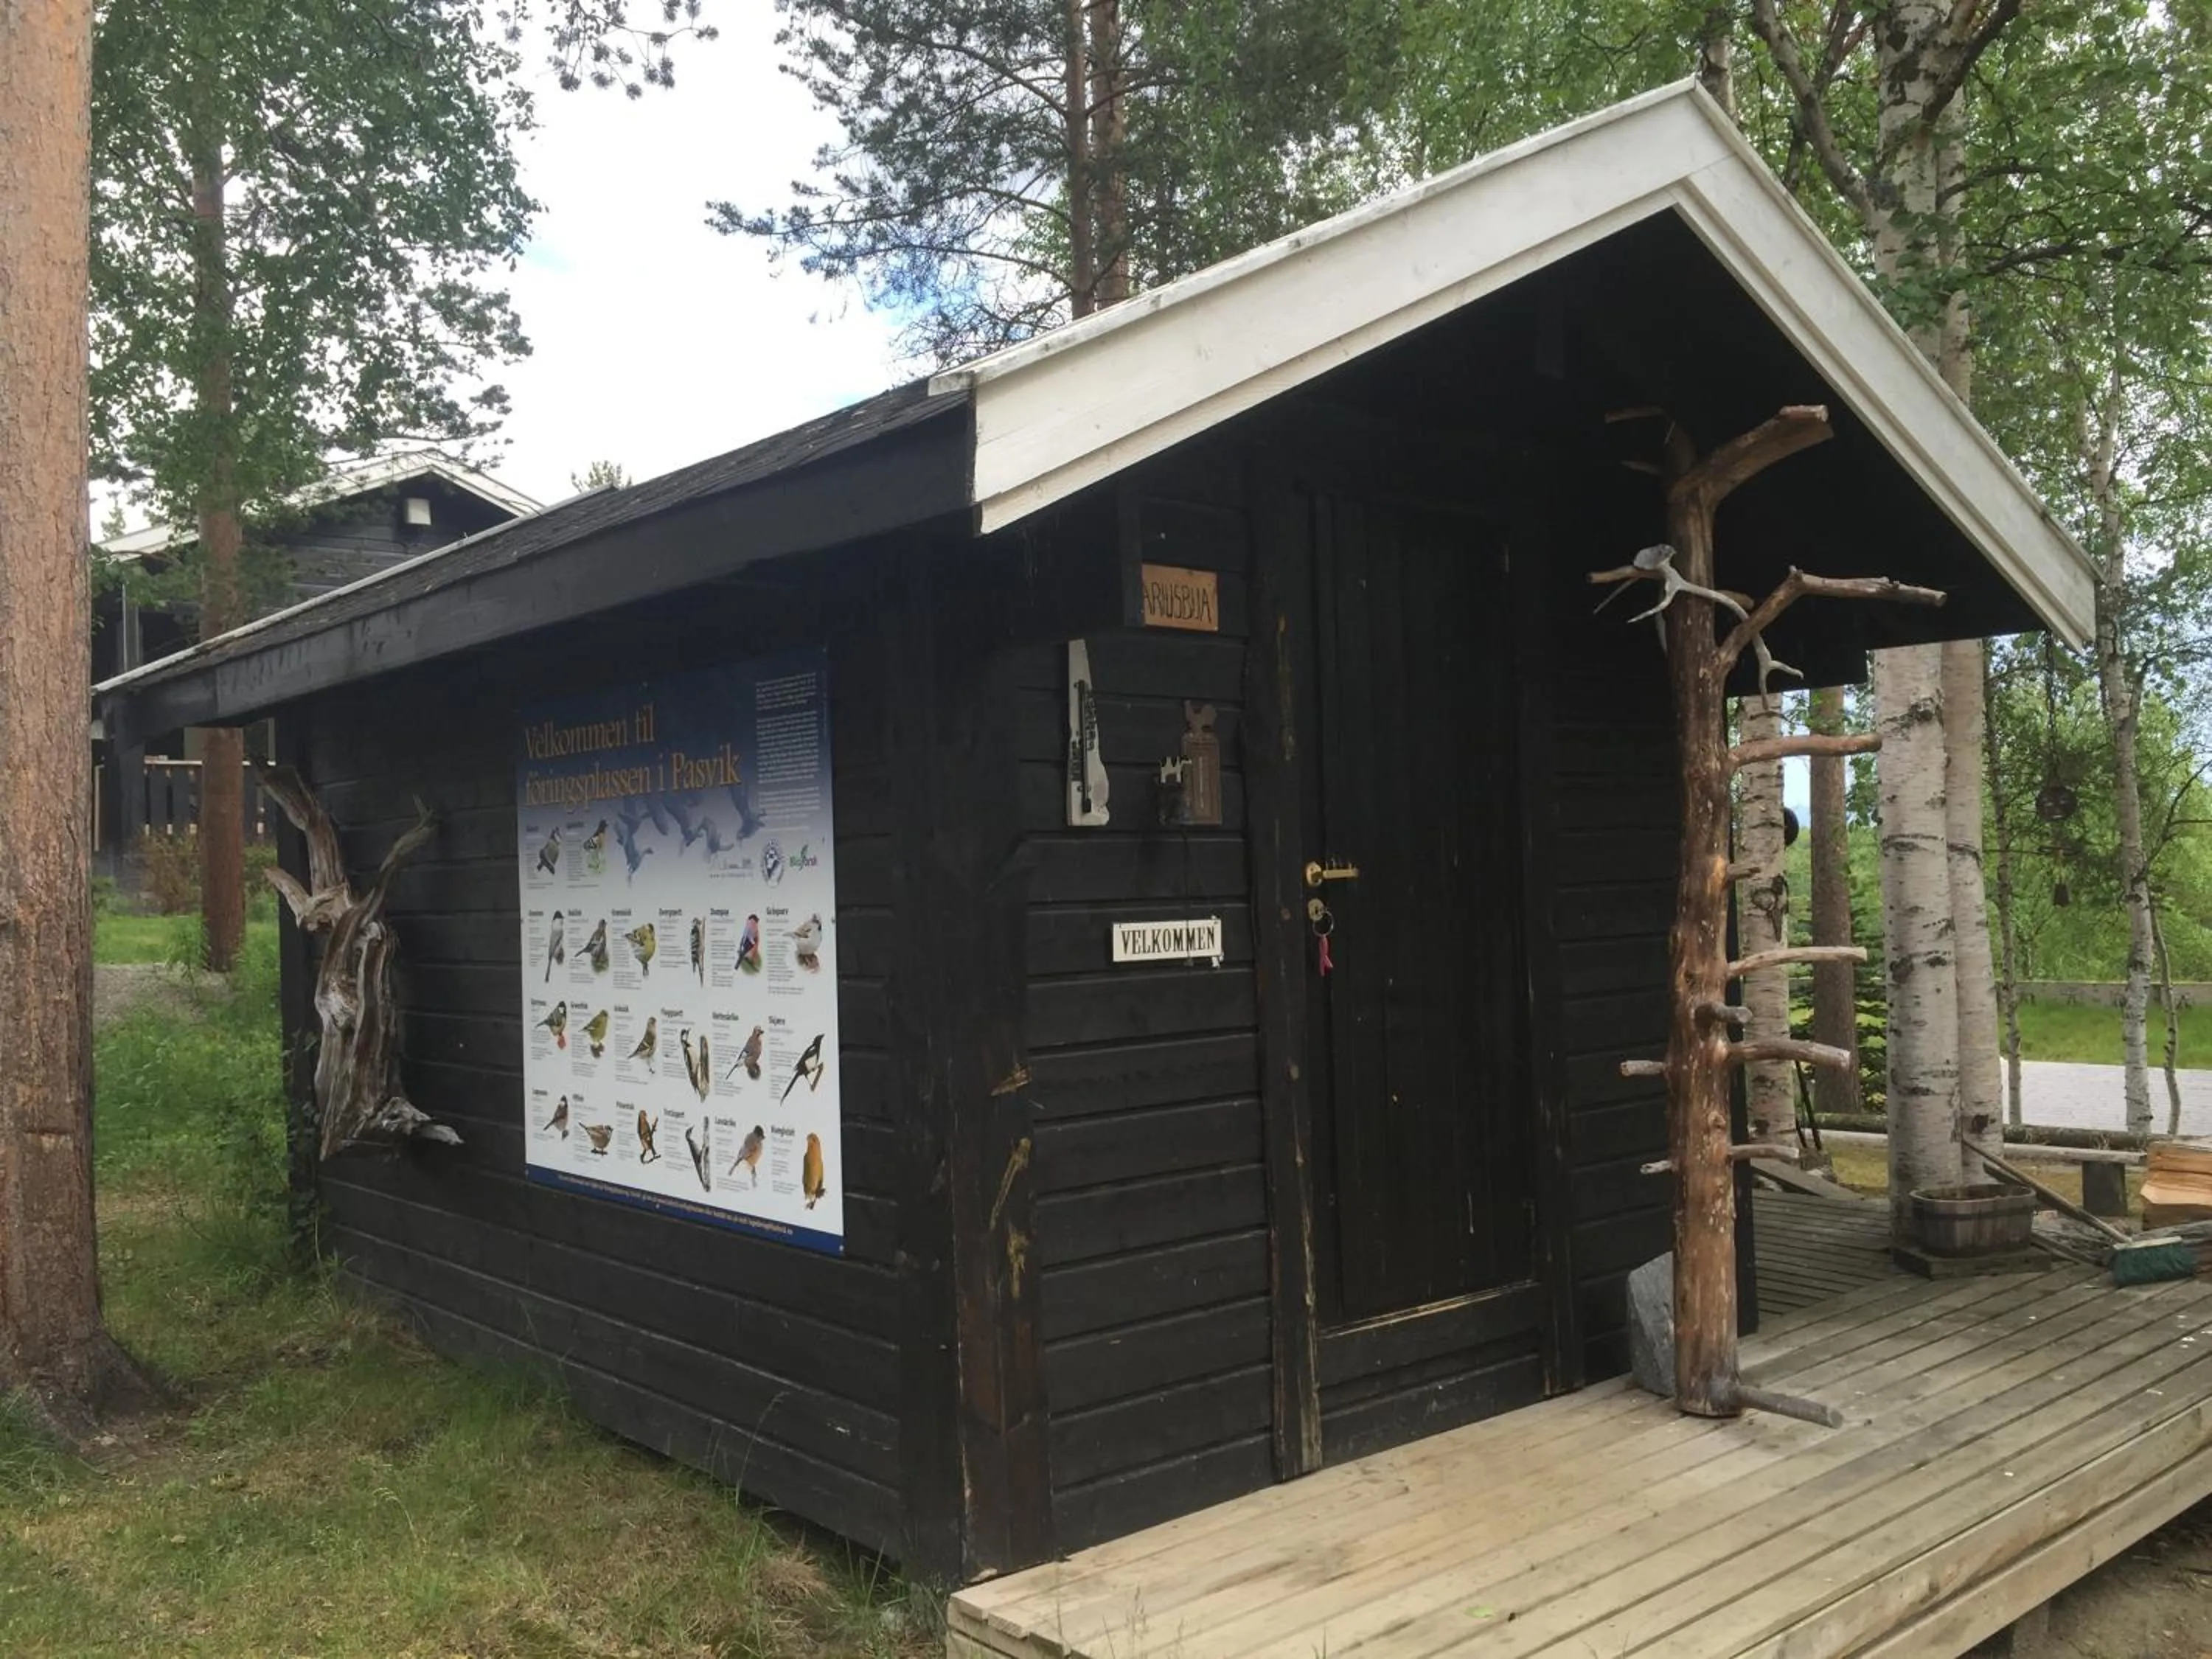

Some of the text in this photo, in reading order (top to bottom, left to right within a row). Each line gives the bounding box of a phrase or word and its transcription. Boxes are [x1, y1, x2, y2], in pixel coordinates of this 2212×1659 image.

[524, 700, 655, 760] Velkommen til
[658, 752, 667, 791] i
[672, 742, 742, 790] Pasvik
[1121, 926, 1215, 955] VELKOMMEN
